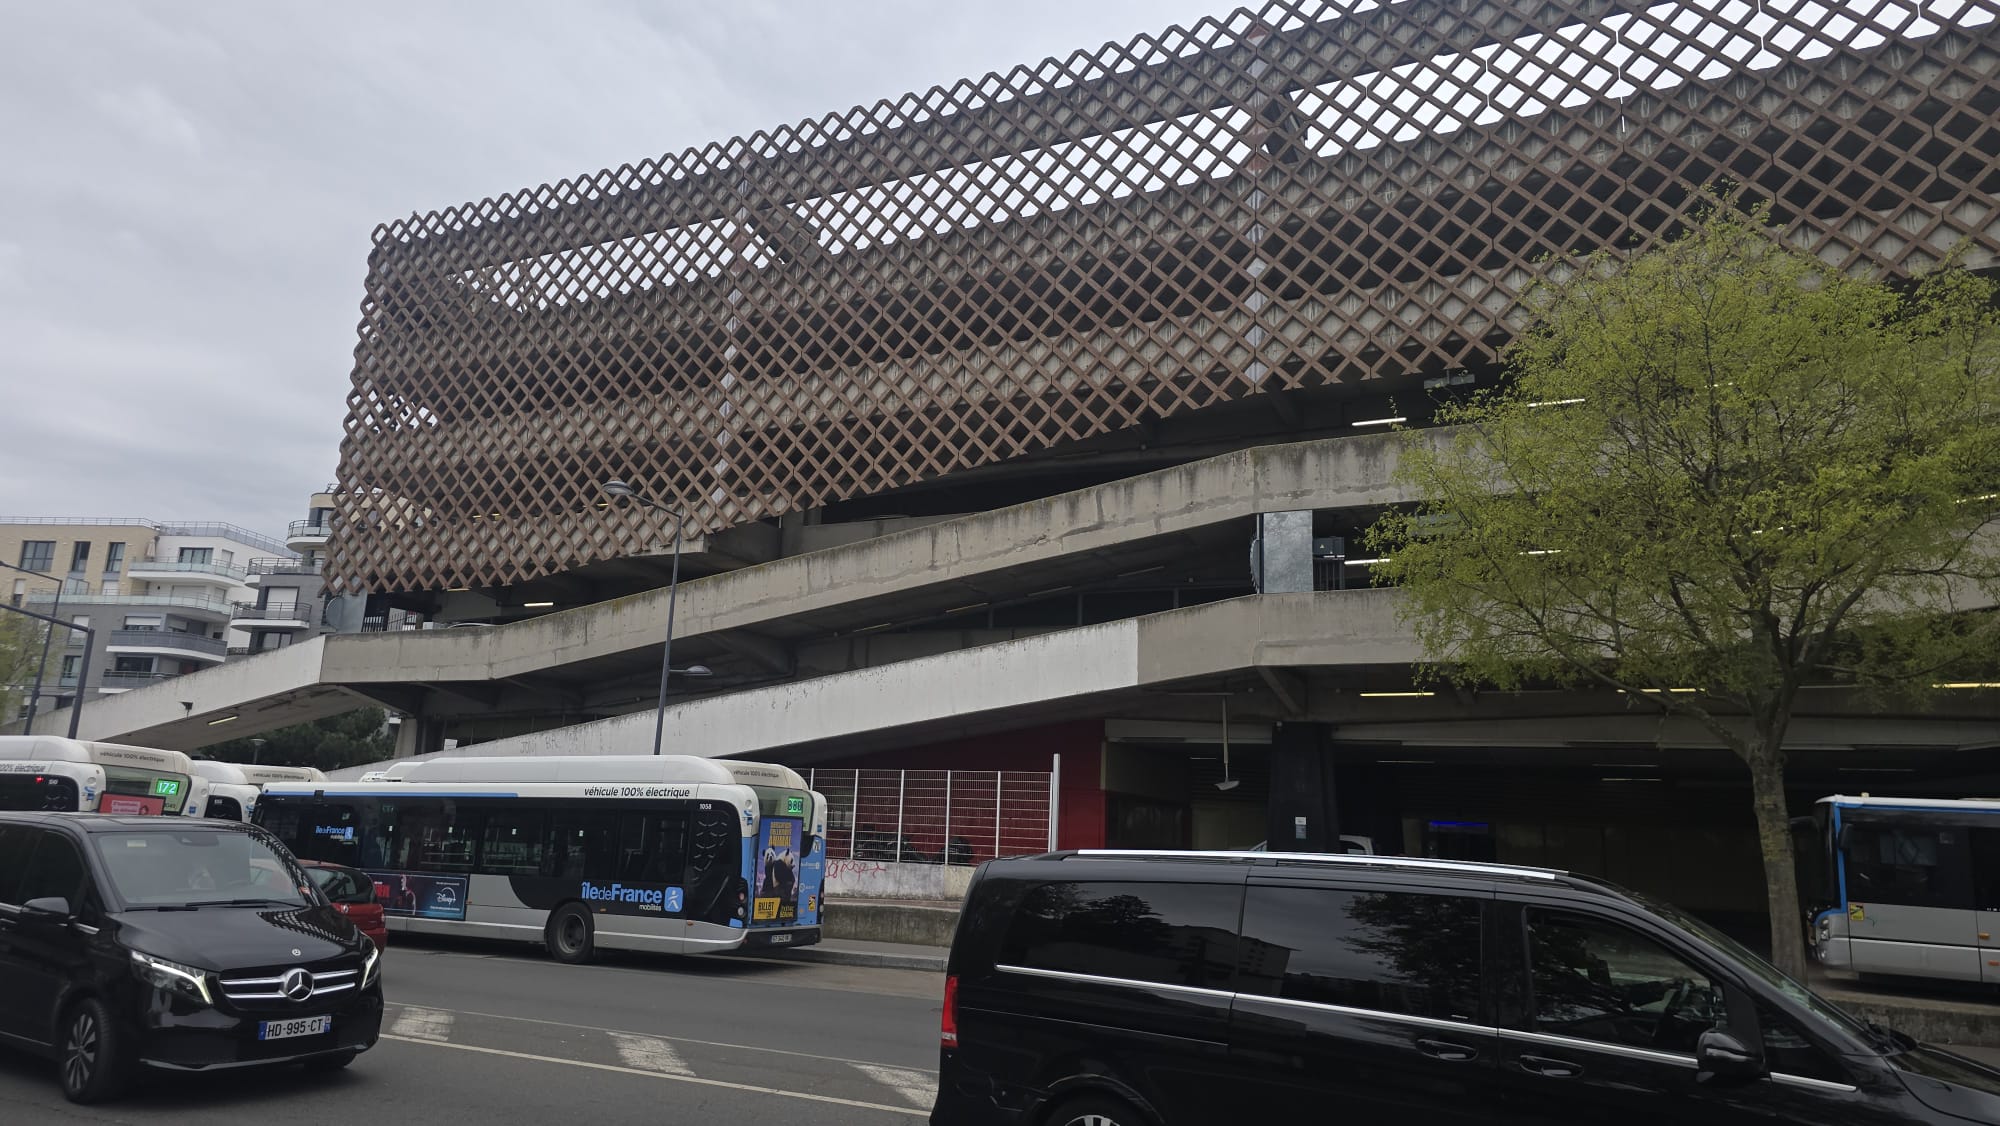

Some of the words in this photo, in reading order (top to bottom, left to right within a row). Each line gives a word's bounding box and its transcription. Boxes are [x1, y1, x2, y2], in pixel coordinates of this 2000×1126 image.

[158, 781, 177, 794] 172
[584, 785, 619, 797] véhicule
[620, 787, 644, 797] 100%
[645, 787, 690, 799] électrique
[639, 903, 662, 912] mobilités
[267, 1018, 324, 1038] HD-995-CT
